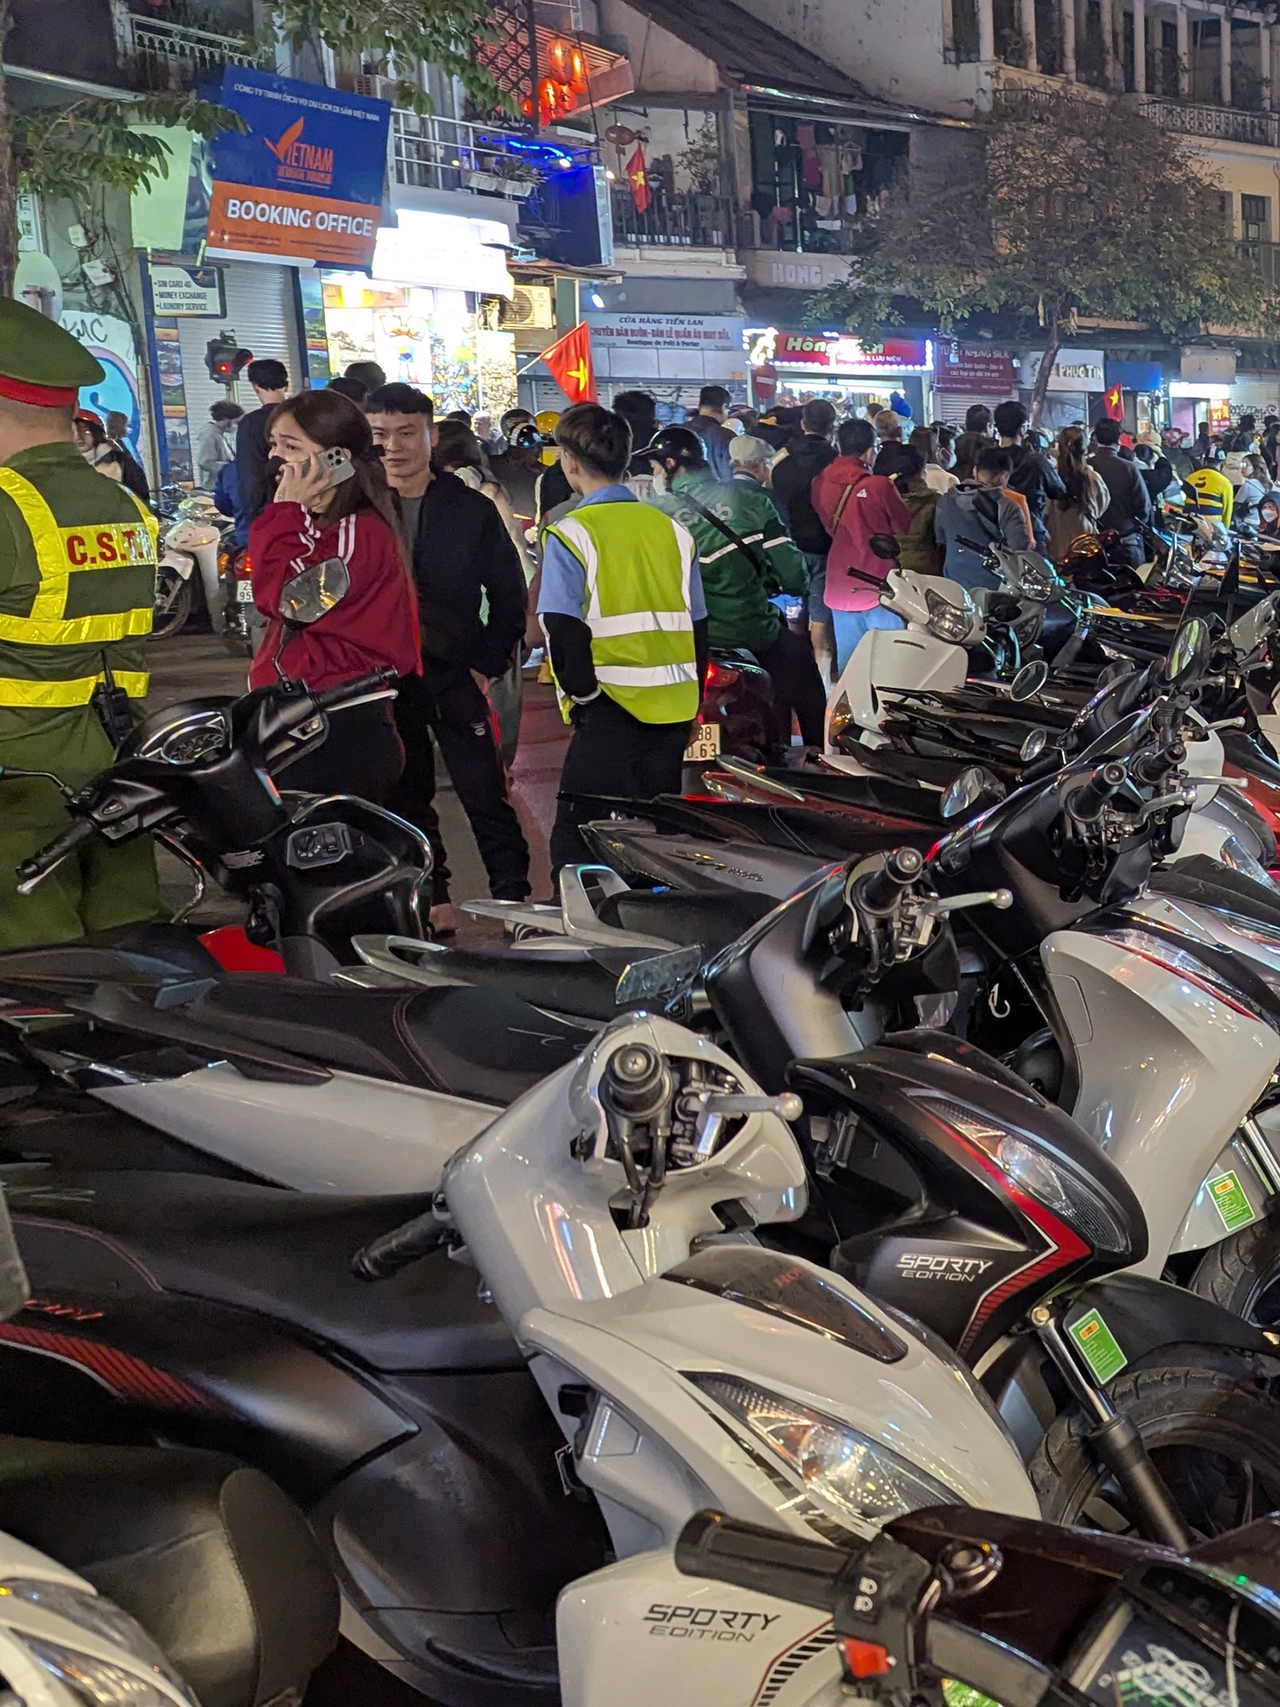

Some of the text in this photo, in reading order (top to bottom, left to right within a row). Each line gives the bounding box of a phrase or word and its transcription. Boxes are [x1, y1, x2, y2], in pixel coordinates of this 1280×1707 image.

[264, 116, 334, 173] VIETNAM
[226, 198, 373, 237] BOOKING OFFICE
[157, 280, 168, 288] SIM
[168, 280, 184, 288] CARD
[158, 291, 207, 300] MONEY EXCHANGE
[159, 302, 208, 311] LAUNDRY SERVICE
[619, 315, 637, 324] CỬA
[638, 317, 663, 325] HÀNG
[687, 318, 704, 326] LAN
[673, 503, 734, 526] Gb
[239, 591, 252, 601] 95
[686, 742, 717, 759] 0.63
[896, 1254, 993, 1274] SPORTY
[901, 1269, 976, 1282] EDITION
[642, 1603, 782, 1631] SPORTY
[649, 1624, 756, 1643] EDITION
